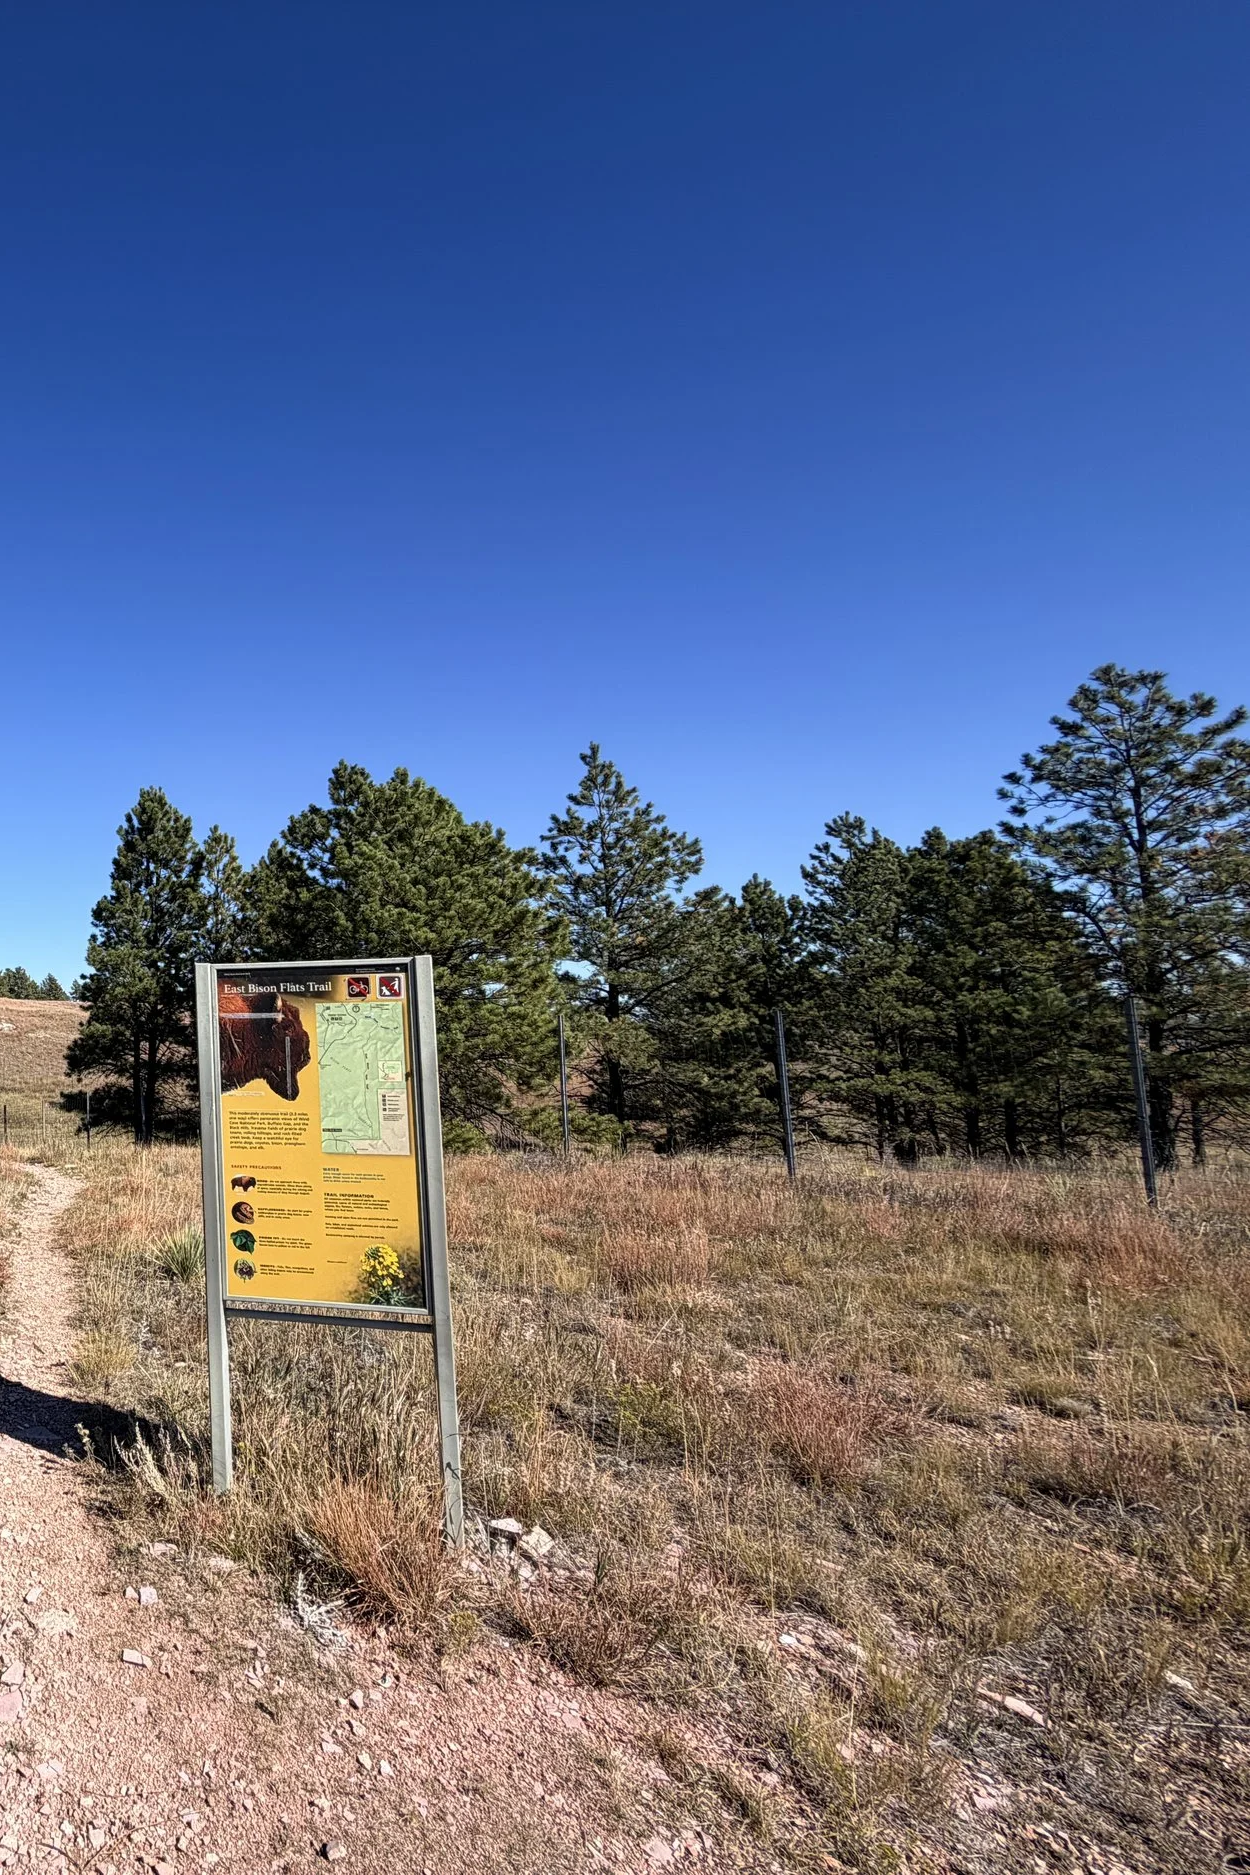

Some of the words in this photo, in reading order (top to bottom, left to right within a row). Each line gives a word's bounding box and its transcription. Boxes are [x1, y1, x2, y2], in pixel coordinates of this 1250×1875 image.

[224, 984, 246, 994] East
[248, 983, 277, 993] Bison
[280, 982, 305, 992] Flats
[307, 981, 332, 991] Trail
